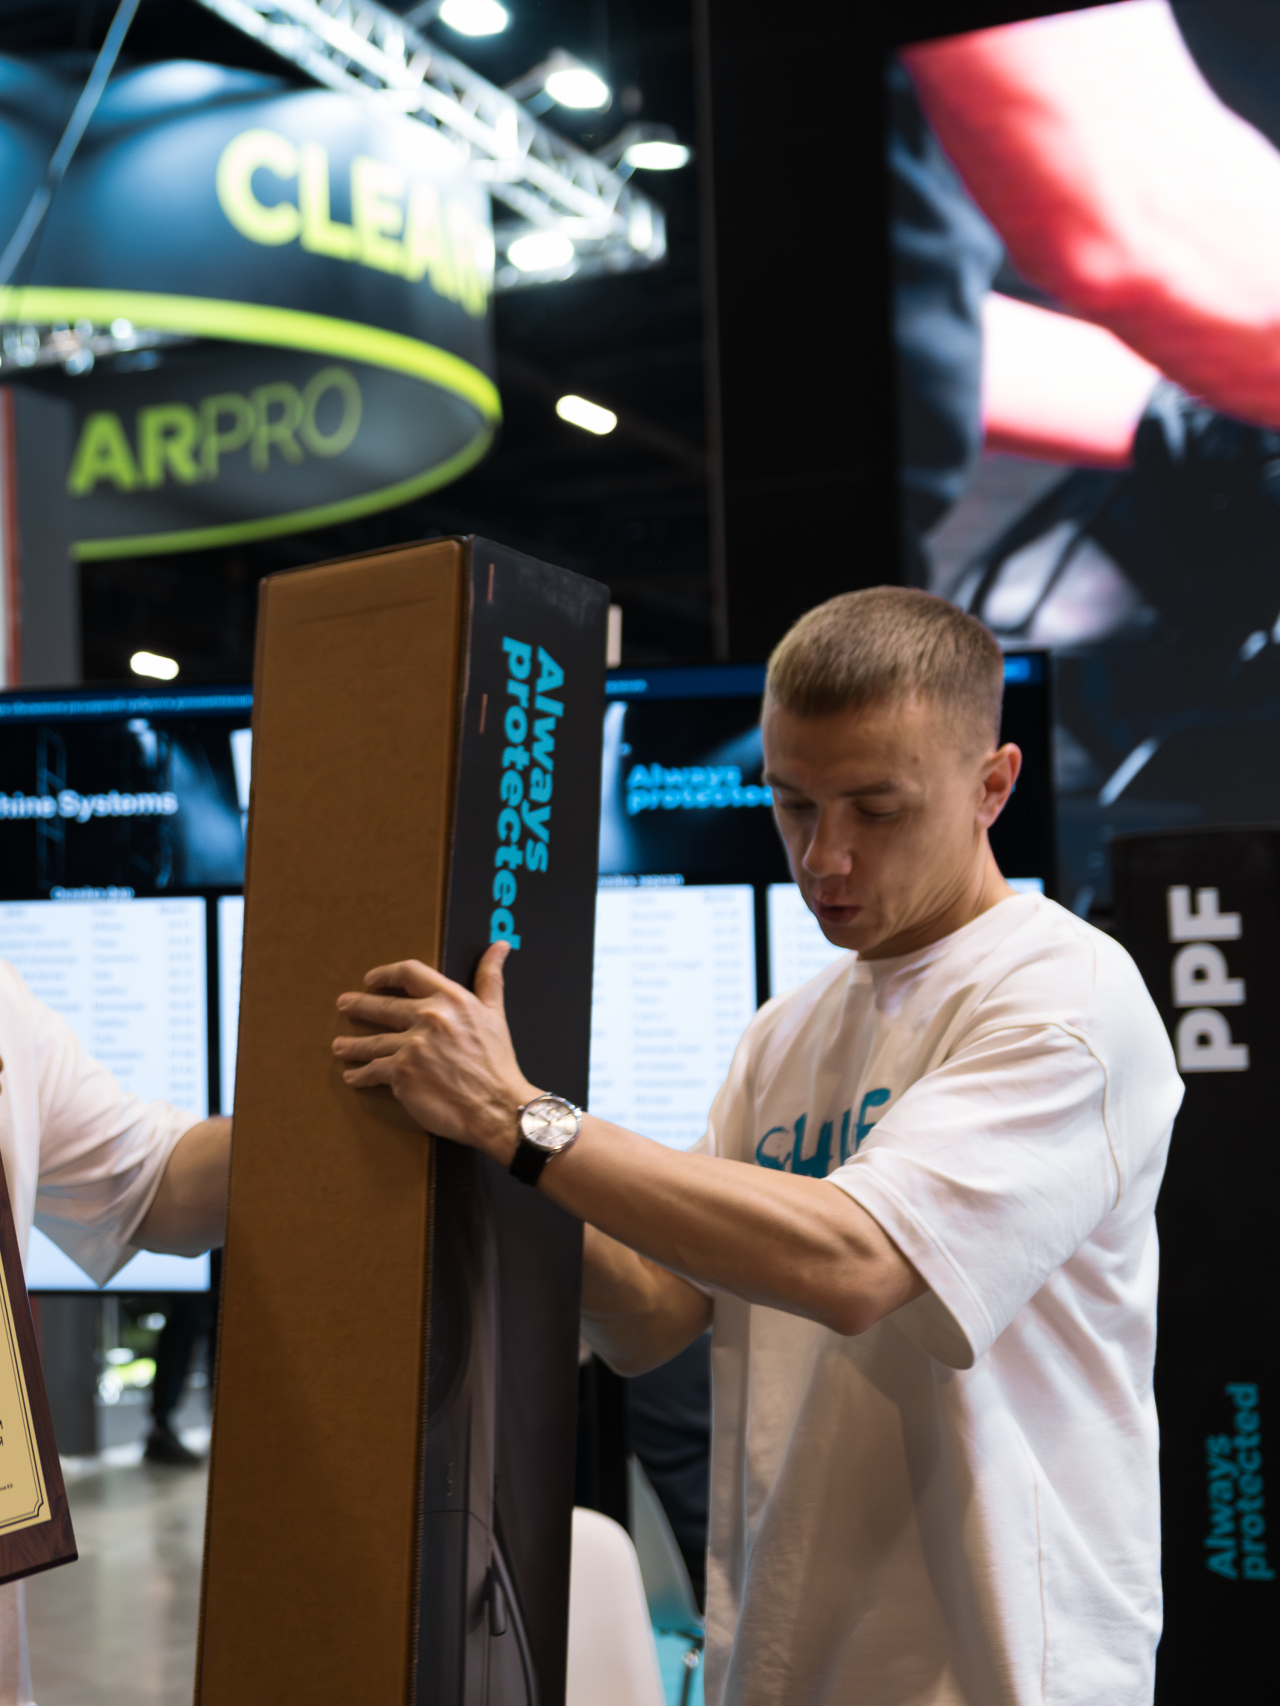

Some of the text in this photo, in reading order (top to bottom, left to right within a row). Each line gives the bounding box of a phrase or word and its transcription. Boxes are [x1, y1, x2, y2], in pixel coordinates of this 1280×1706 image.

[58, 789, 178, 823] Systems
[489, 635, 532, 950] protected
[521, 644, 564, 873] Always
[1168, 884, 1250, 1073] PPF
[1204, 1433, 1239, 1581] Always
[1225, 1382, 1276, 1581] protected
